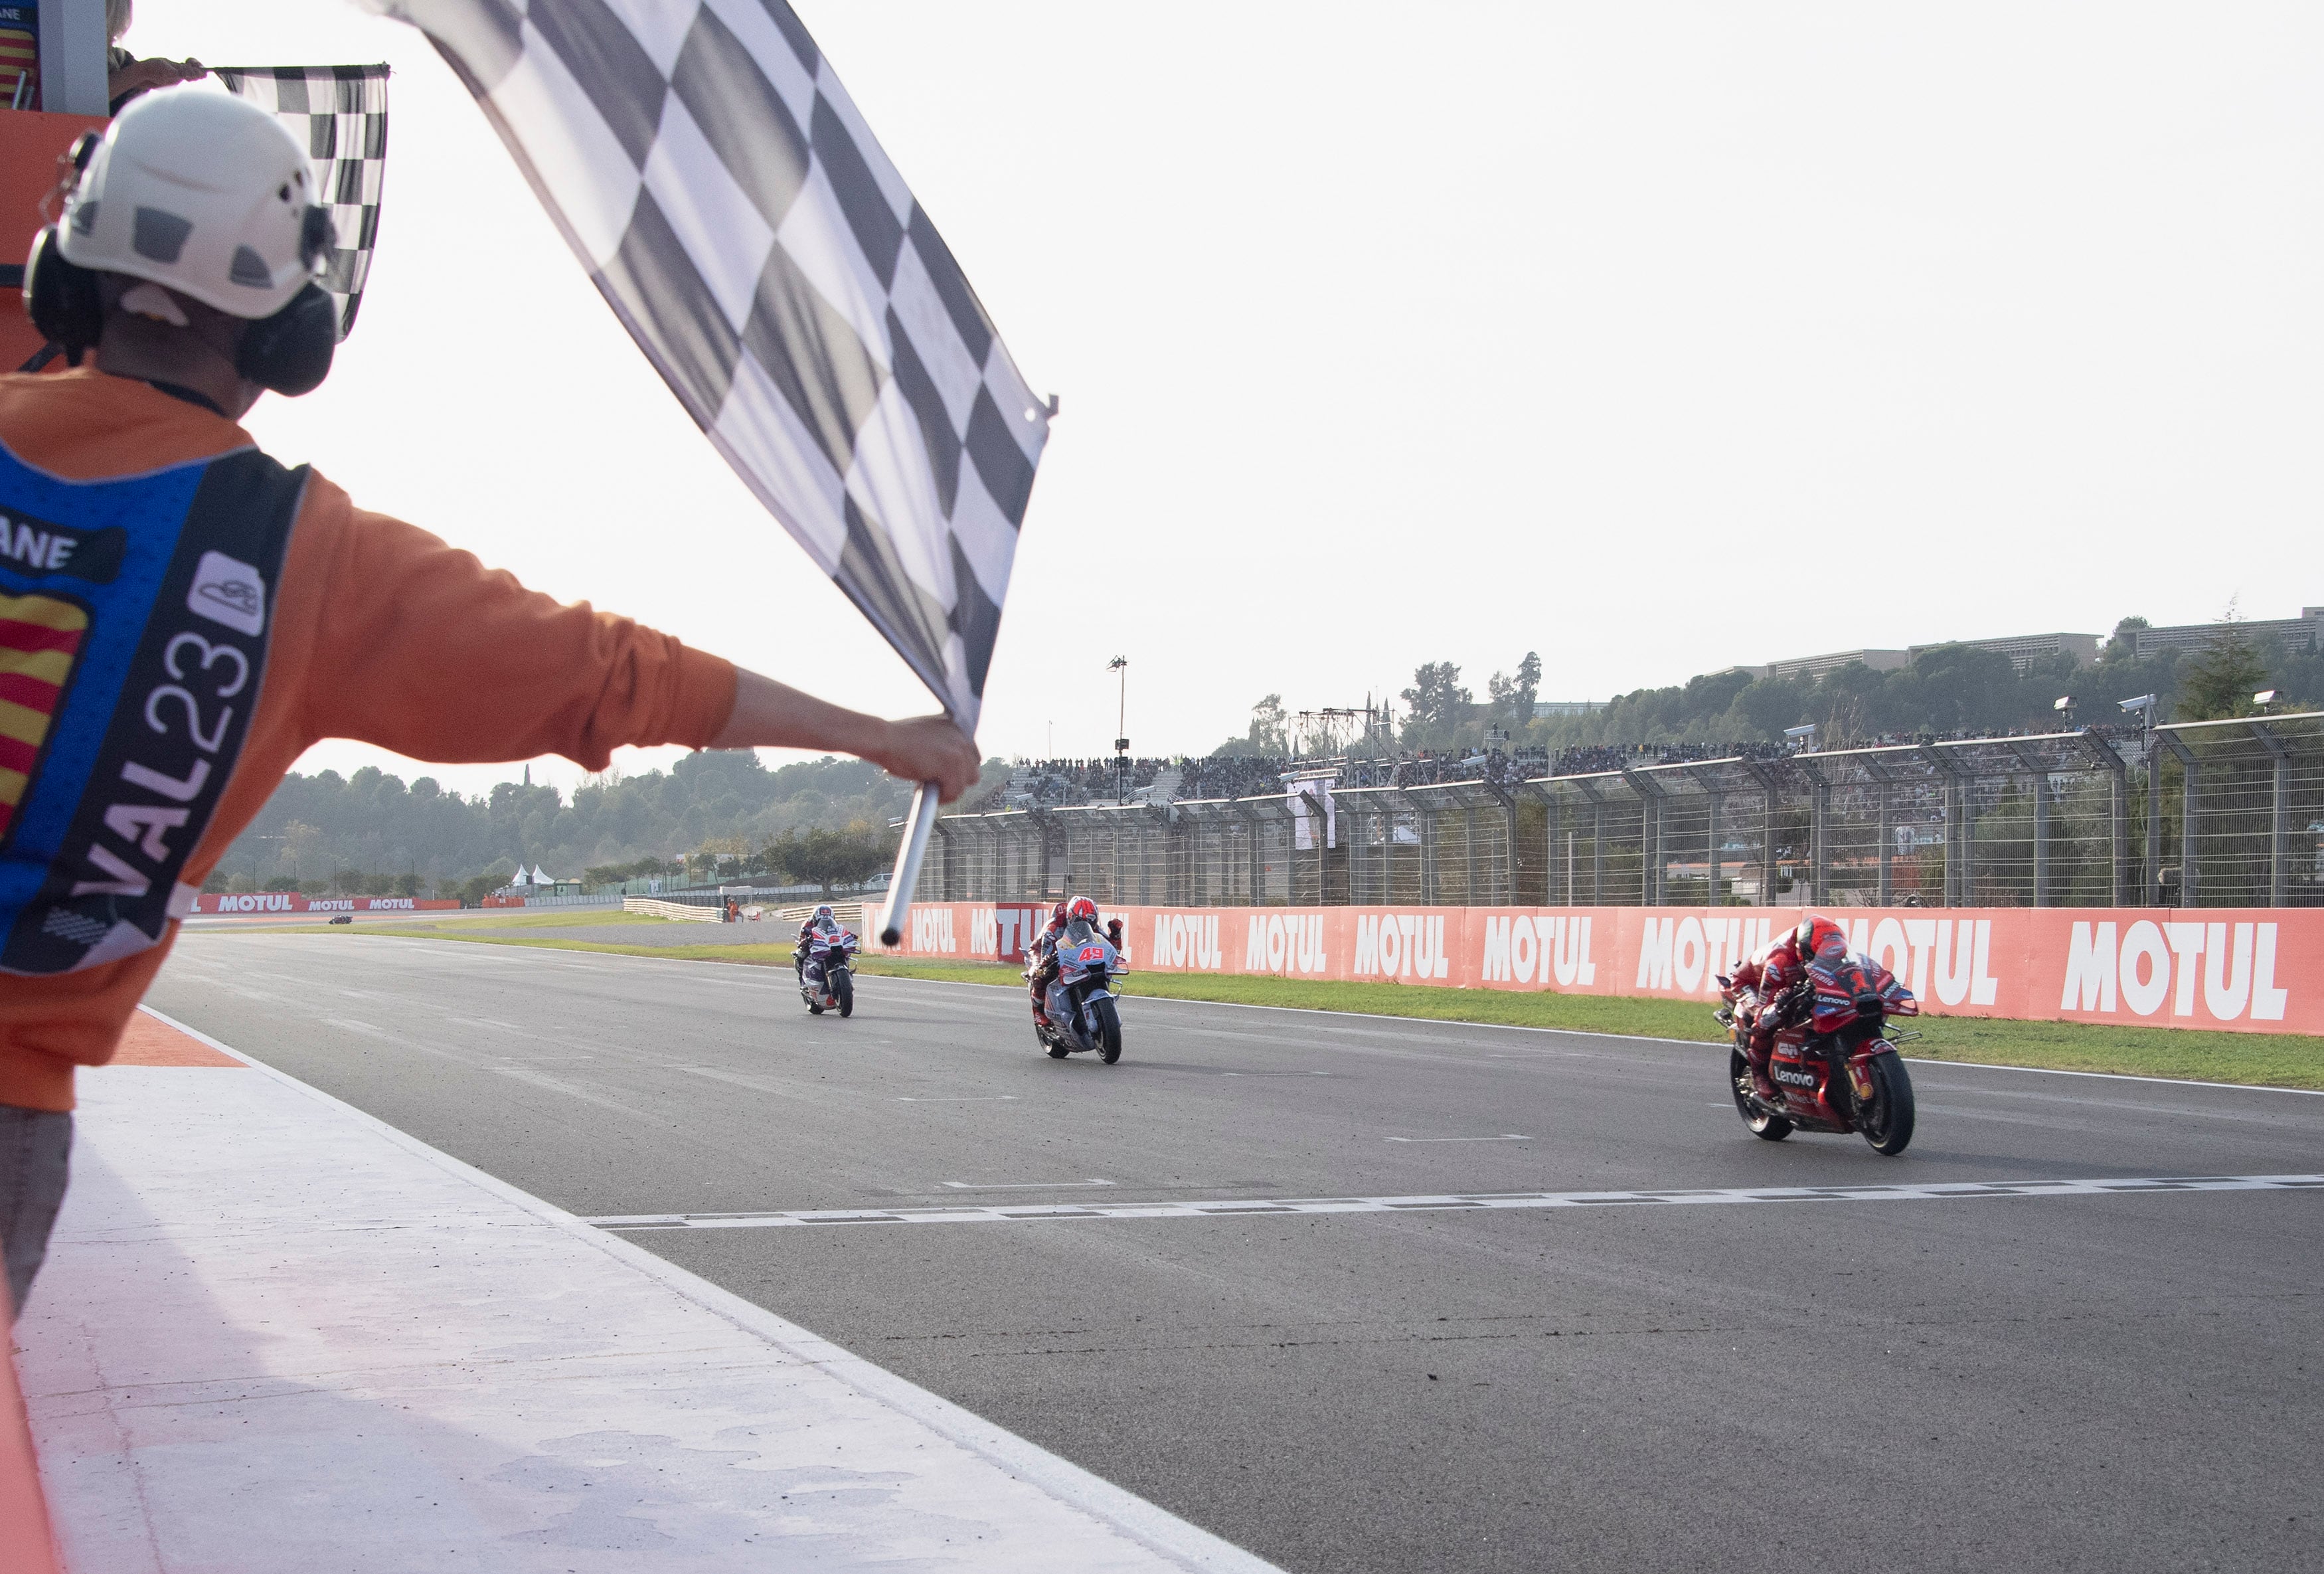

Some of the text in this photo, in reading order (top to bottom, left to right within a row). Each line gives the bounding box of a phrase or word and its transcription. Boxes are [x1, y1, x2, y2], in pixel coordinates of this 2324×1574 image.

[0, 8, 21, 21] NE
[71, 632, 249, 897] VAL23
[218, 894, 293, 912] MOTUL
[308, 900, 355, 911] MOTUL
[369, 899, 415, 910] MOTUL
[912, 908, 956, 953] MOTUL
[1153, 913, 1222, 970] MOTUL
[1245, 913, 1327, 974] MOTUL
[1353, 913, 1449, 980] MOTUL
[1078, 946, 1105, 962] 49
[1481, 915, 1597, 986] MOTUL
[2061, 919, 2288, 1021] MOTUL
[1817, 994, 1851, 1006] Lenovo
[1774, 1065, 1815, 1087] Lenovo
